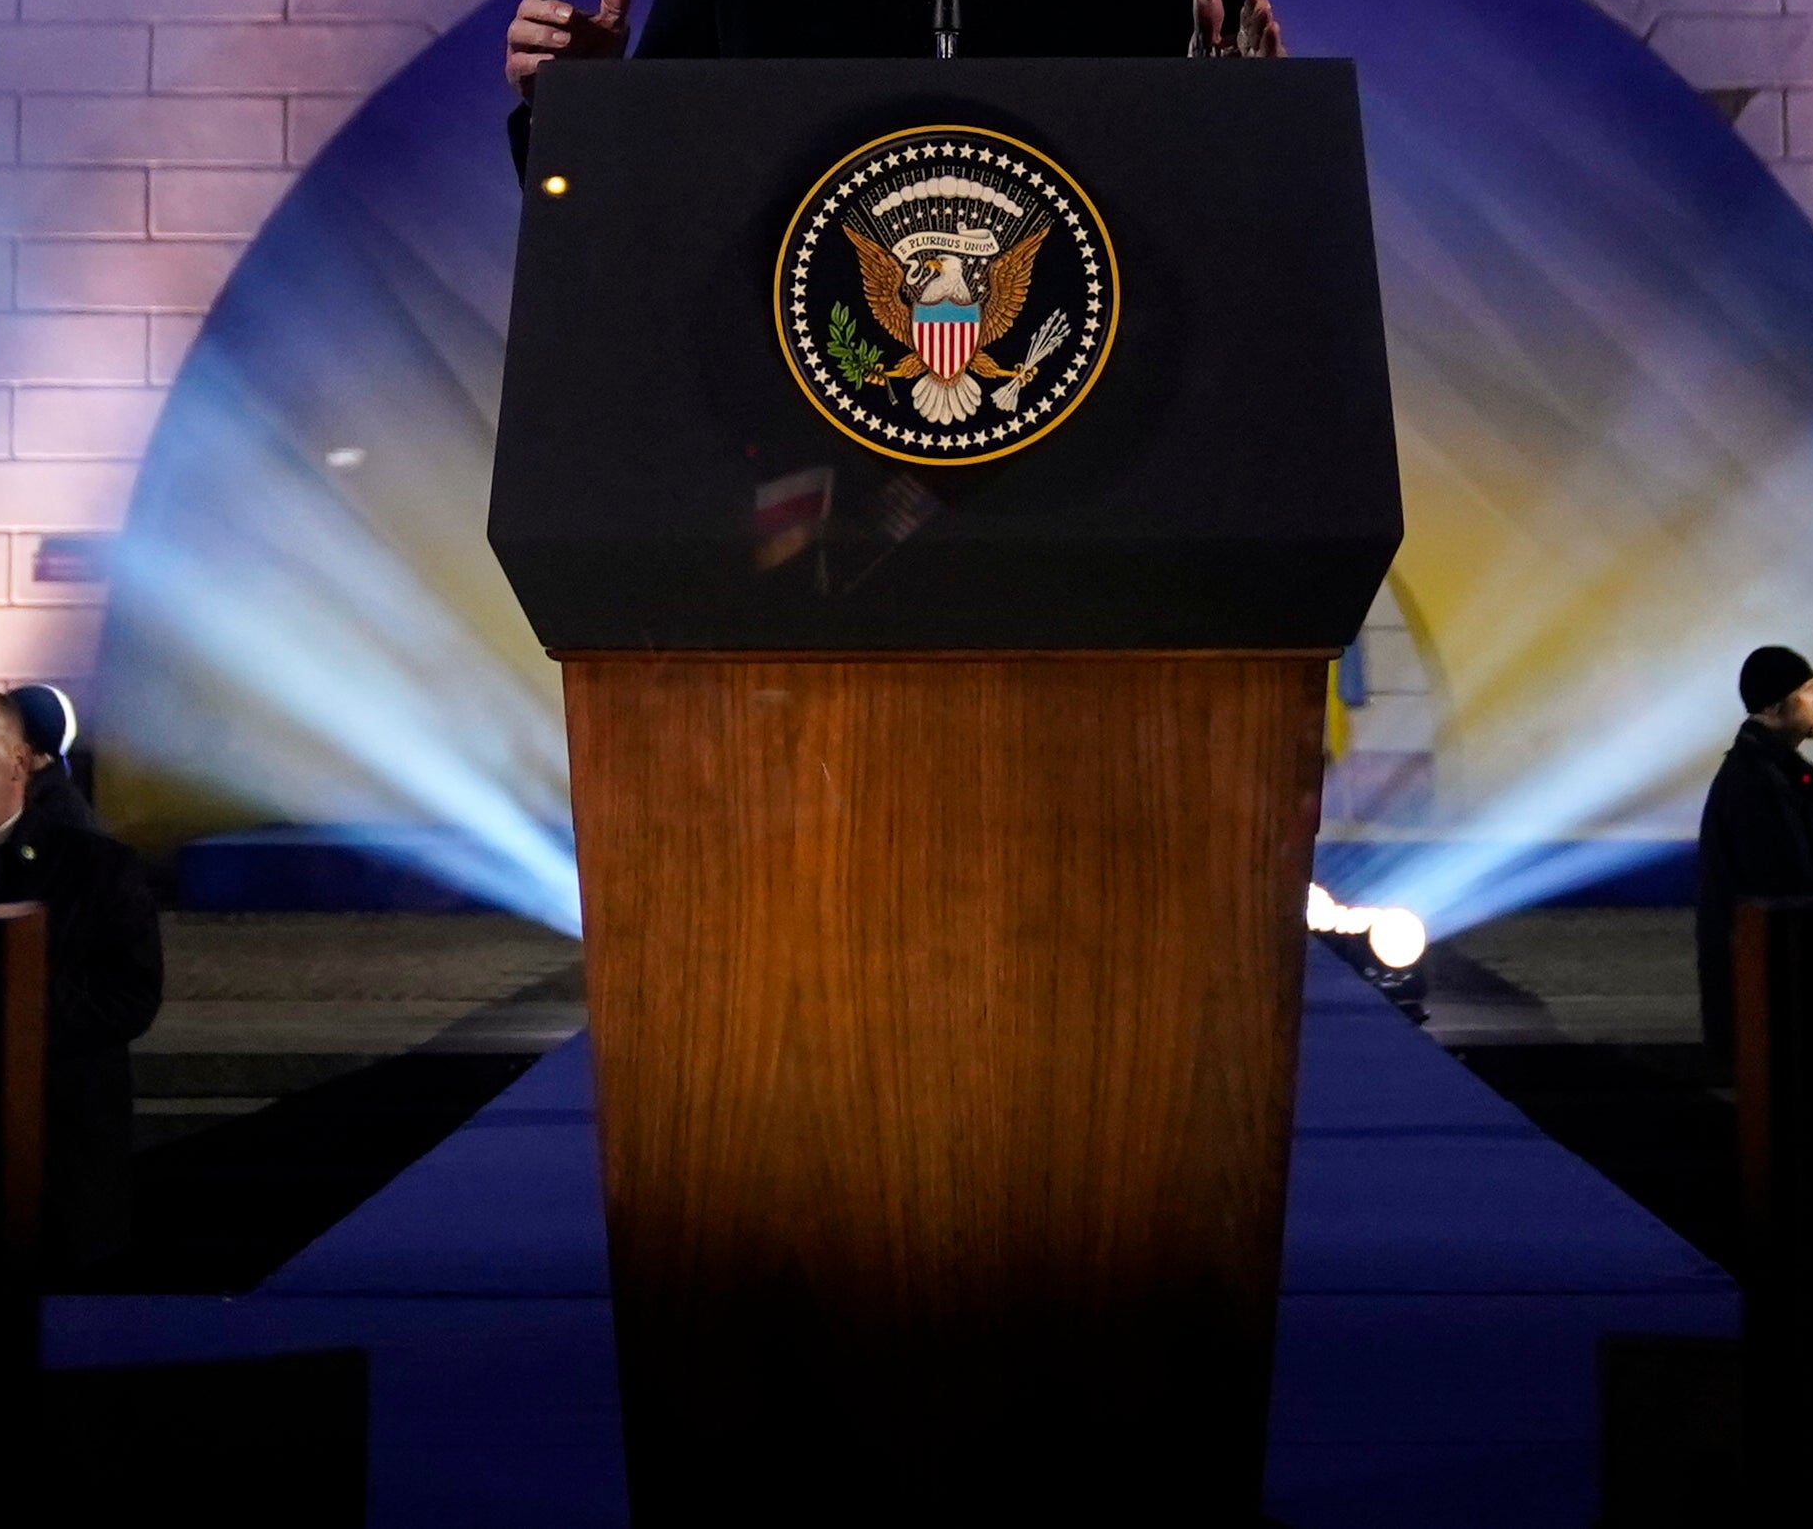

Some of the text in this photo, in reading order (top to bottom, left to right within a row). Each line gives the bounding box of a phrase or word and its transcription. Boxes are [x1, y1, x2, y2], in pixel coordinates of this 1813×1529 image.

[898, 236, 995, 255] E PLURIBUS UNUM
